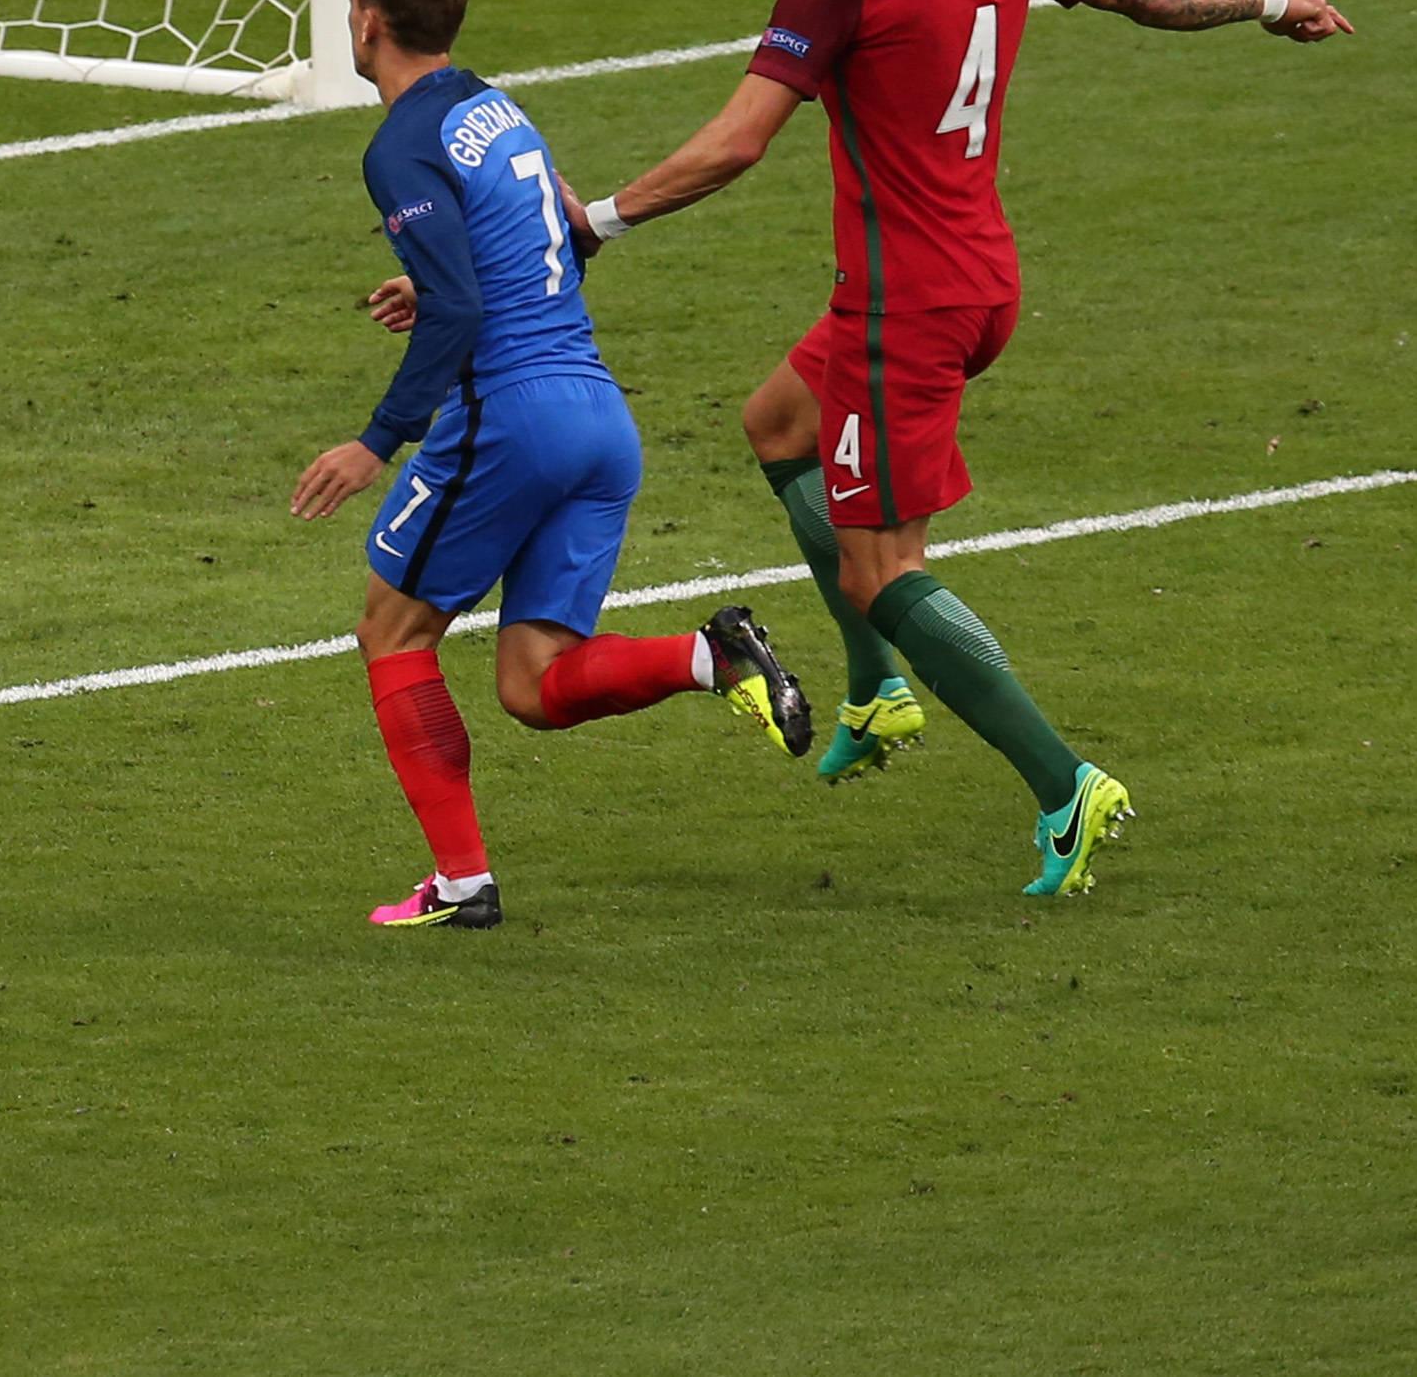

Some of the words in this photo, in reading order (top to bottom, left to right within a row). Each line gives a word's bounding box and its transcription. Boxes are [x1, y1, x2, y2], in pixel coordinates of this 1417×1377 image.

[935, 4, 997, 159] 4
[509, 149, 565, 296] 7
[833, 413, 863, 479] 4
[388, 475, 433, 533] 7
